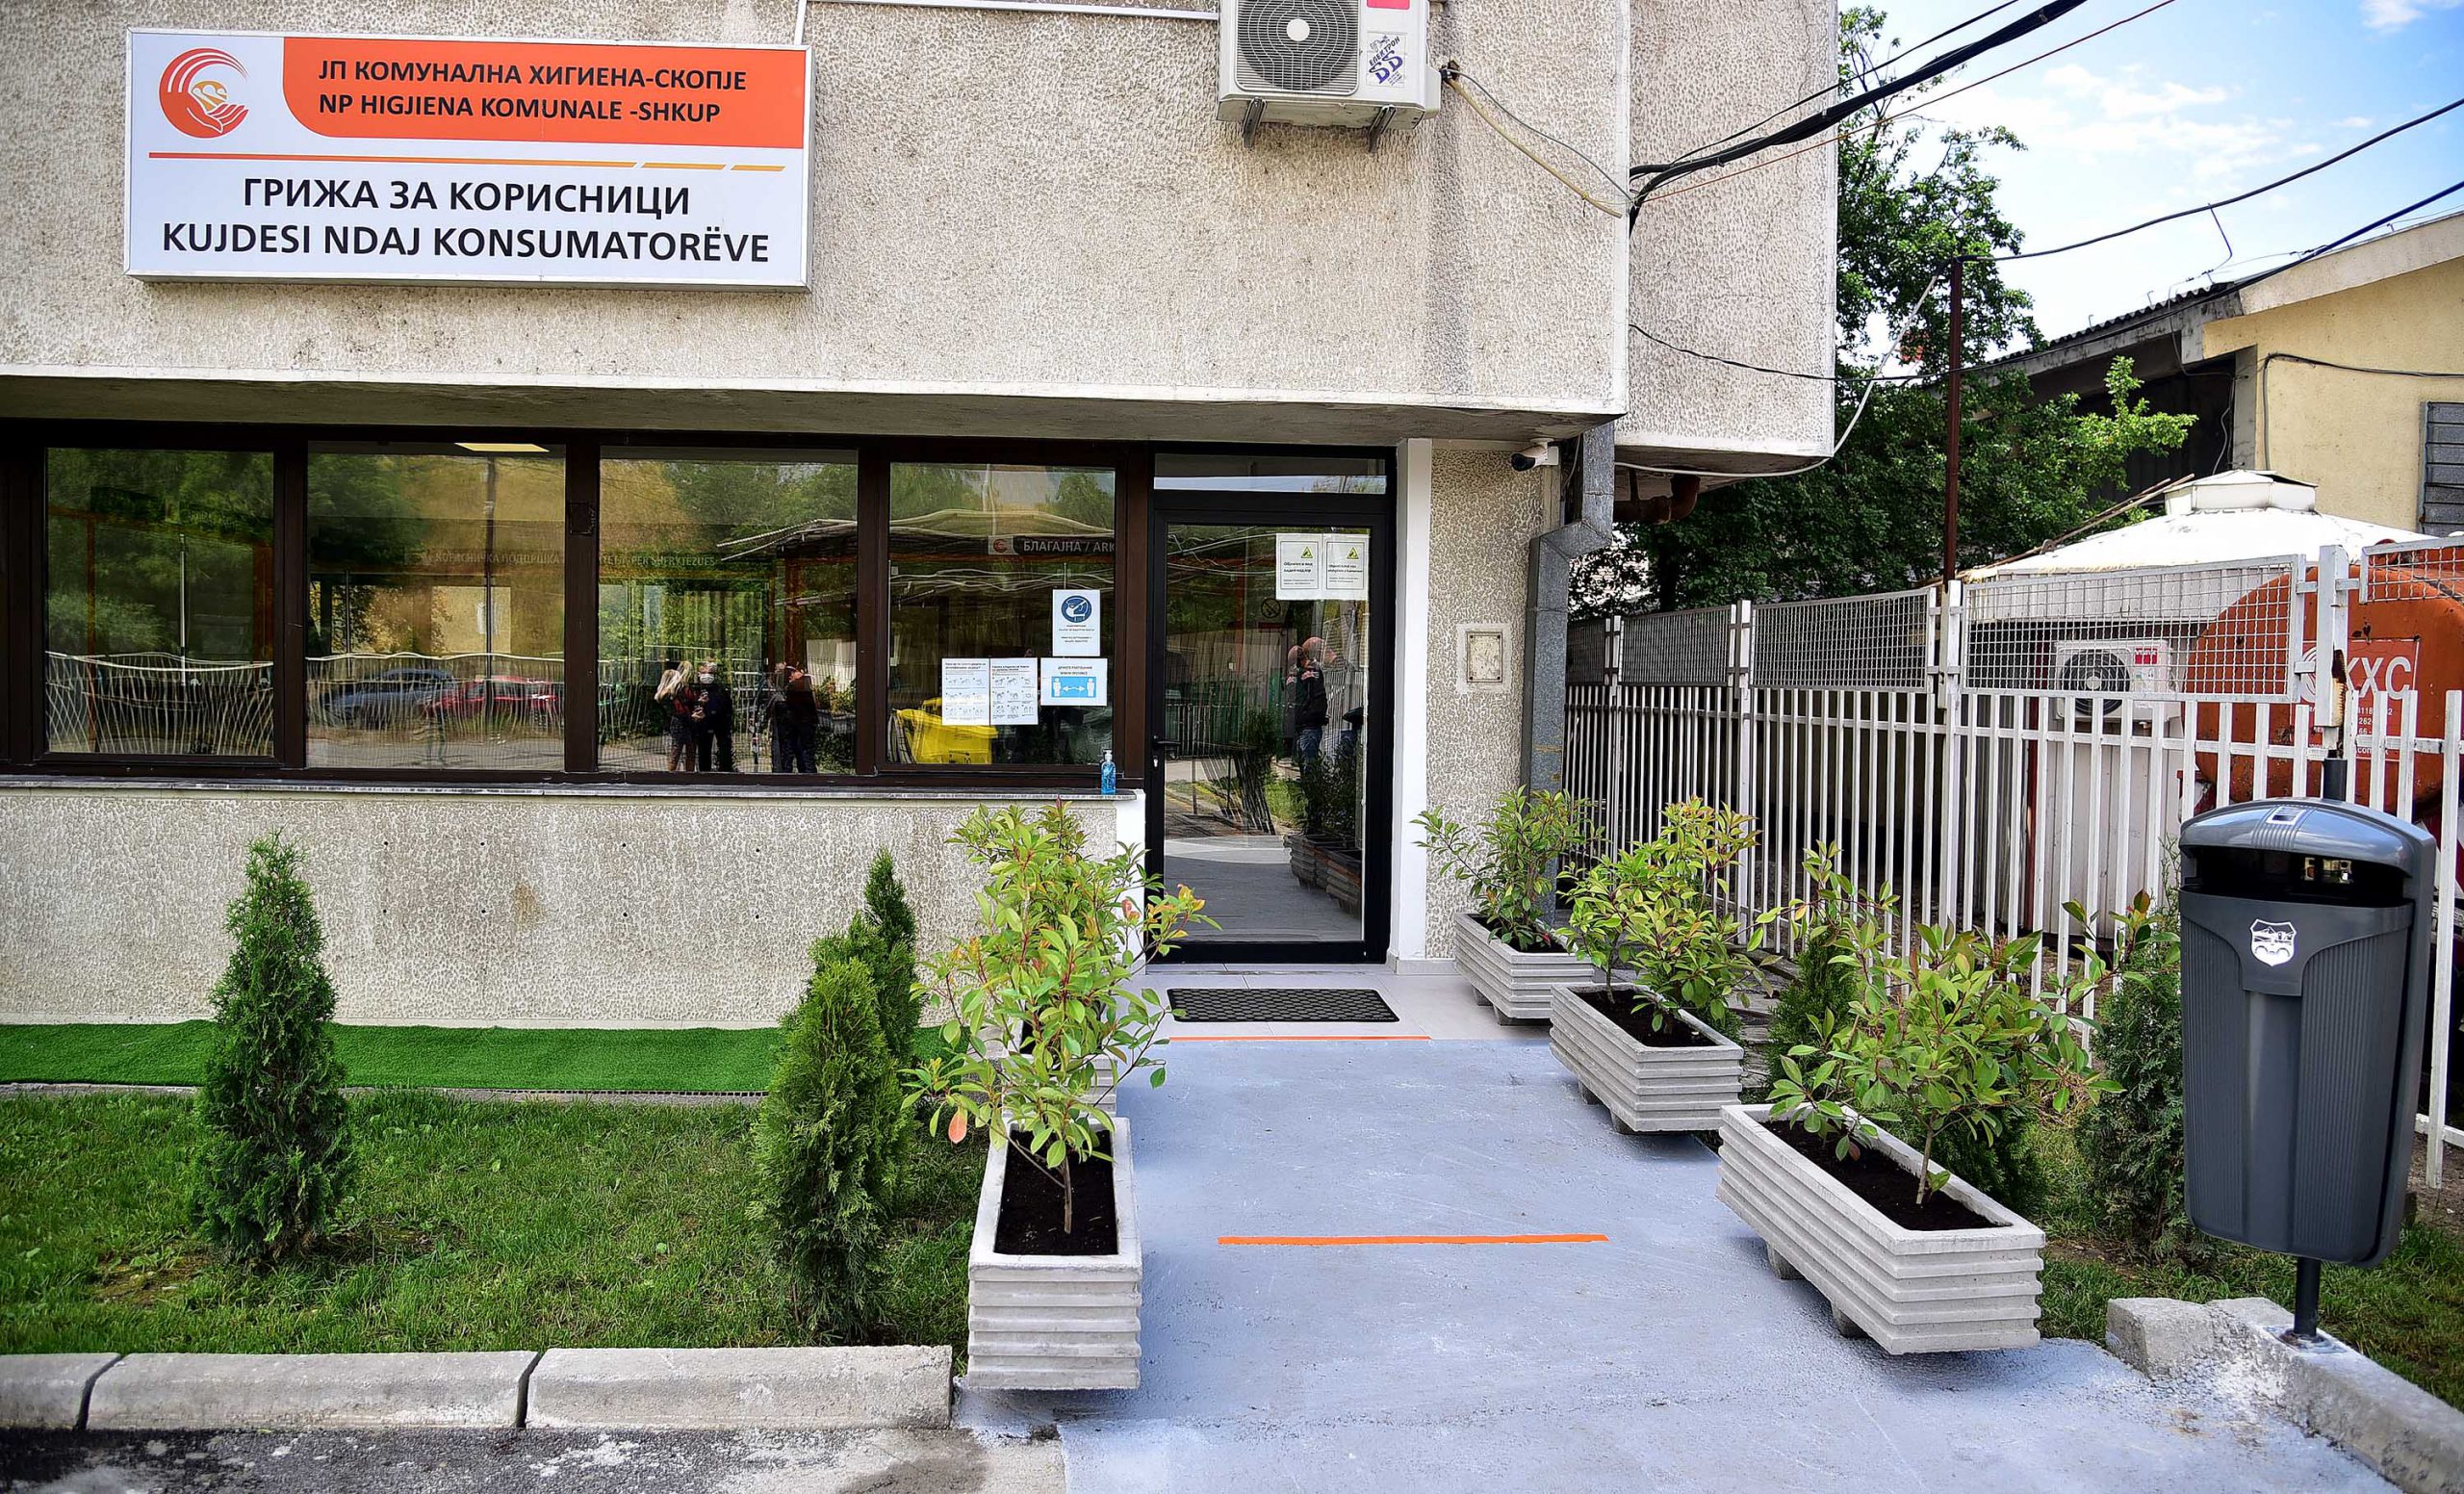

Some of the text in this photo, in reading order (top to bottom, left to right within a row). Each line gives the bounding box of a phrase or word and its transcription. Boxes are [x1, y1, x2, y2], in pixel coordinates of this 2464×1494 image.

[319, 60, 747, 90] ЈП КОМУНАЛНА ХИГИЕНА-СКОПЈЕ
[319, 93, 721, 122] NP HIGJIENA KOMUNALE -SHKUP
[244, 178, 690, 220] ГРИЖА ЗА КОРИСНИЦИ
[163, 222, 769, 263] KUJDESI NDAJ KONSUMATORËVE
[1023, 540, 1082, 553] БЛАГАЈНА
